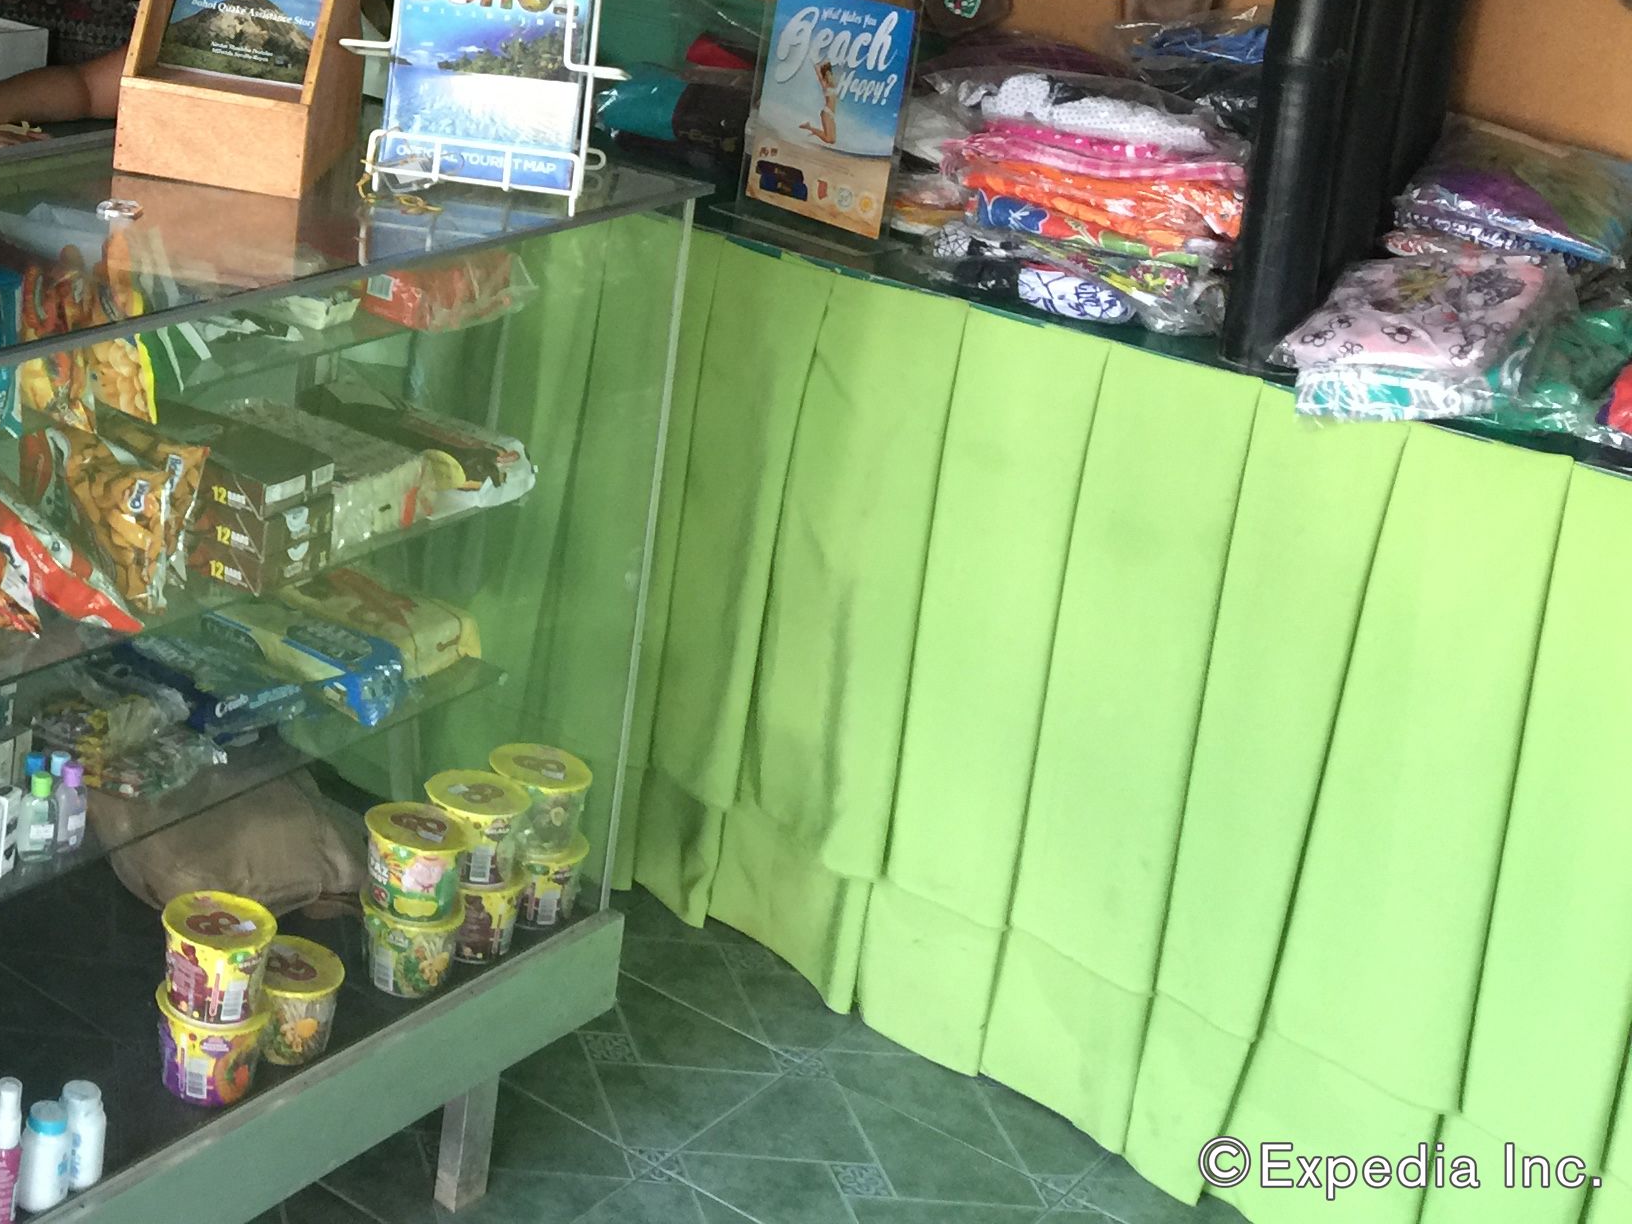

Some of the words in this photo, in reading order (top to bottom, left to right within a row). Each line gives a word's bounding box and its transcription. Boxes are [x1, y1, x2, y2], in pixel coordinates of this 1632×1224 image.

[218, 2, 247, 16] Quake
[294, 14, 317, 30] Story
[776, 6, 899, 84] Beach
[835, 70, 898, 106] Happy?
[462, 152, 523, 172] TOURIT
[523, 160, 558, 175] MAP
[211, 484, 227, 505] 12
[216, 525, 231, 546] 12
[209, 559, 225, 580] 12
